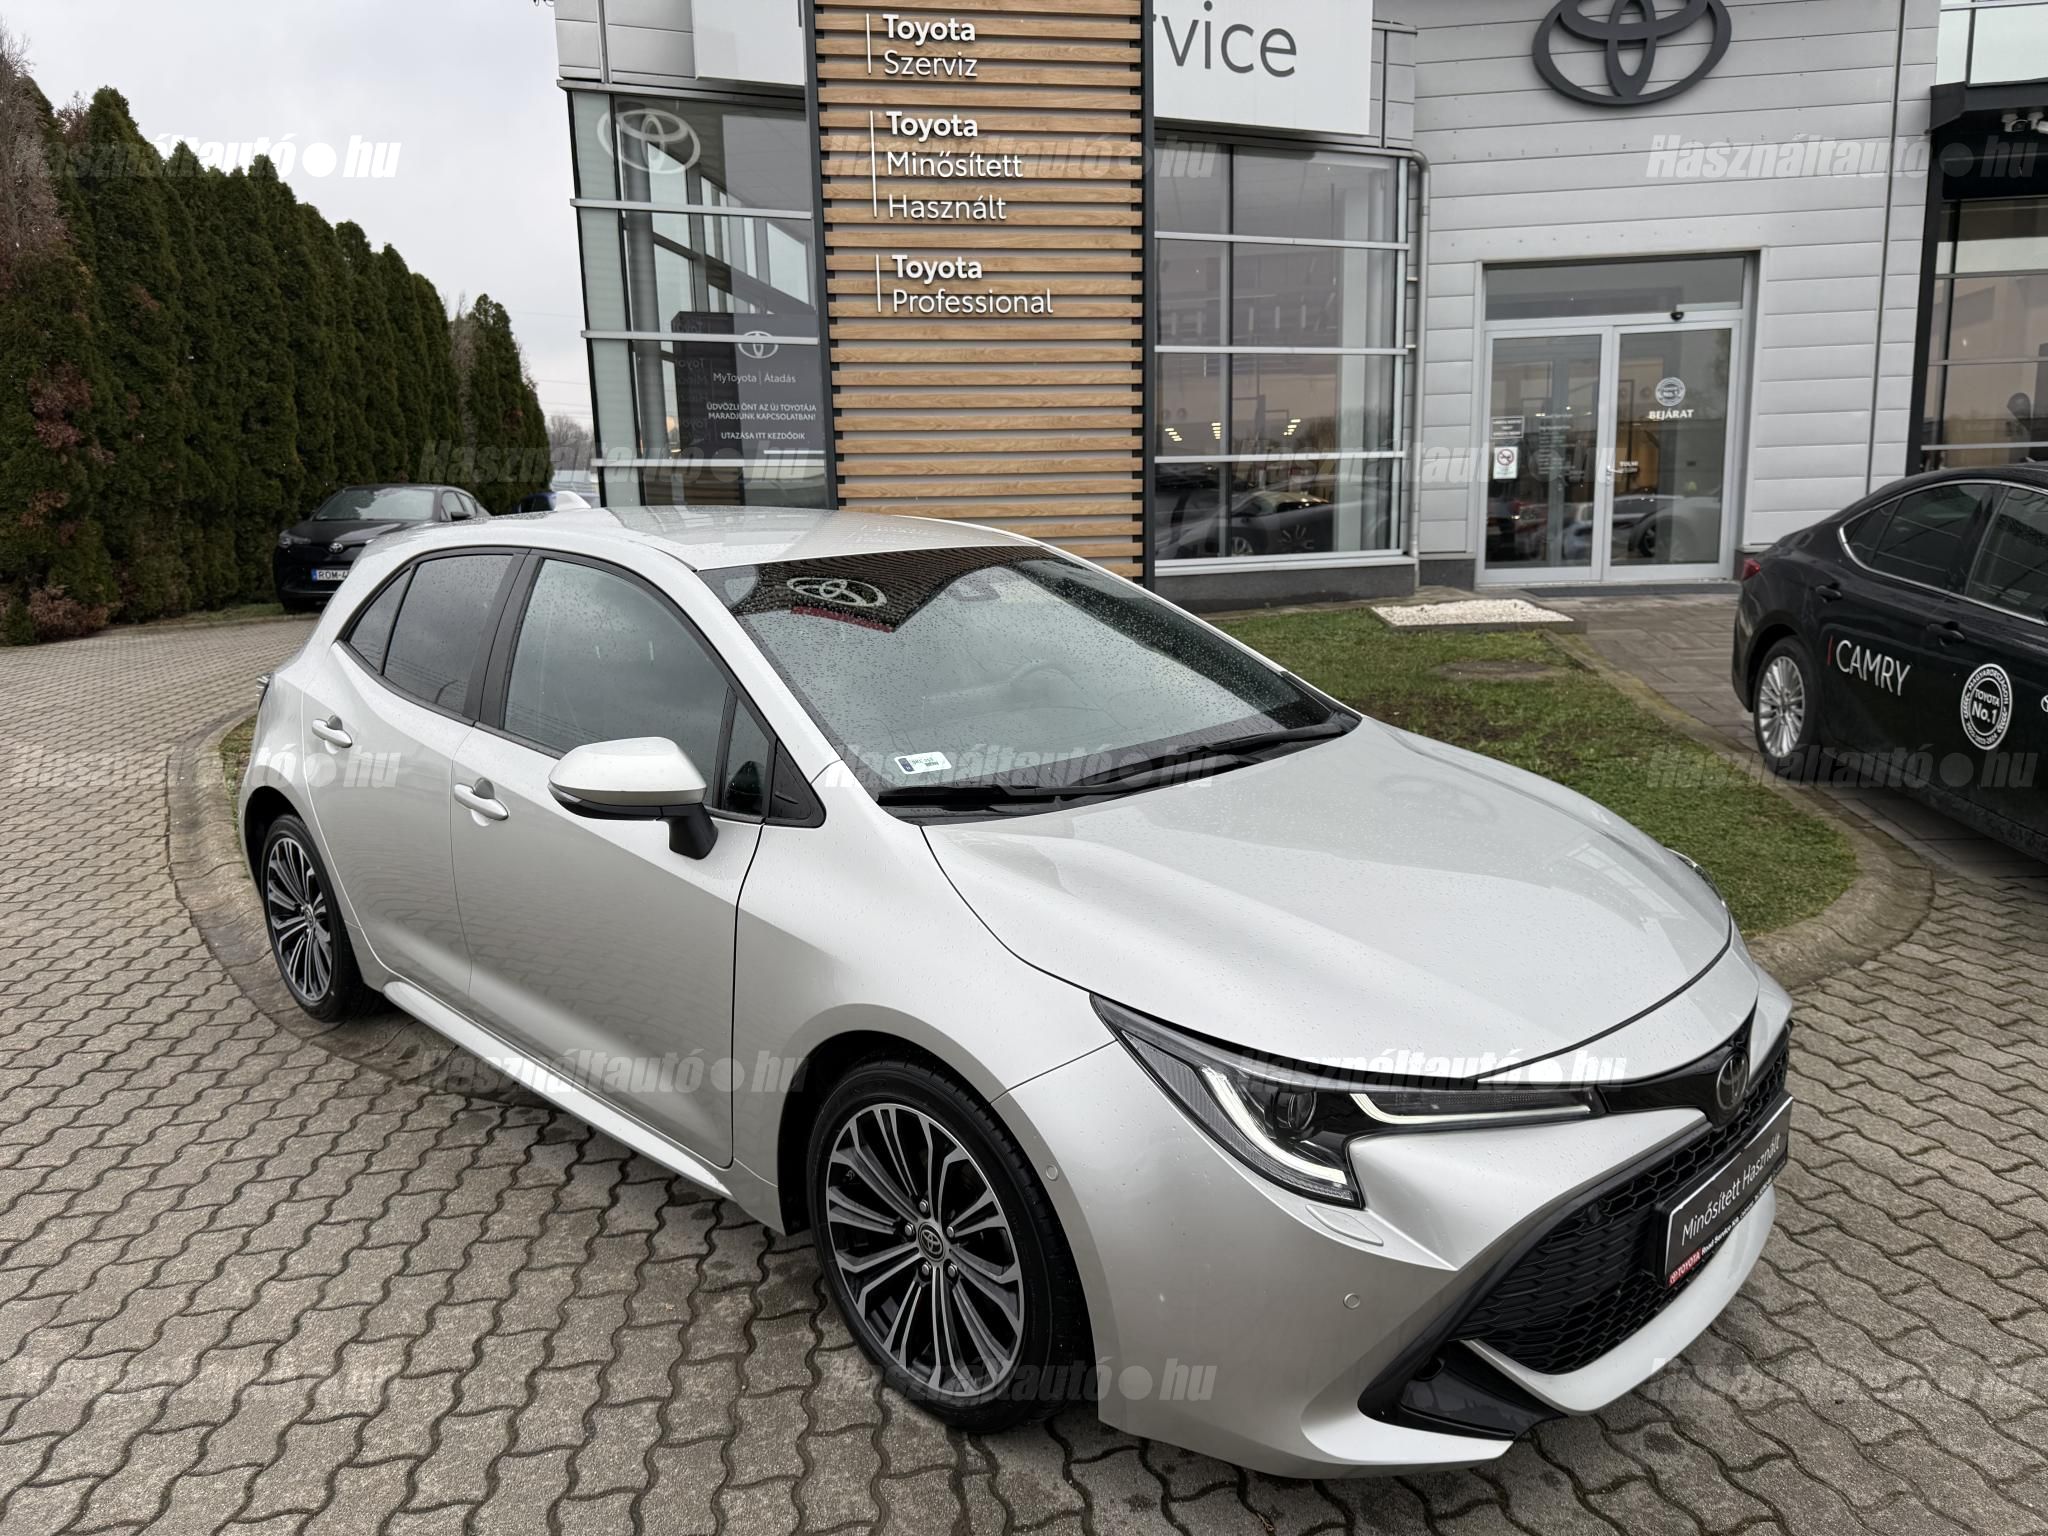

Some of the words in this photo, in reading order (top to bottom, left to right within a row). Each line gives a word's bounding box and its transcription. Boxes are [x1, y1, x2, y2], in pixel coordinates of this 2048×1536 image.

[882, 13, 976, 46] Toyota
[1153, 0, 1297, 78] vice
[884, 50, 978, 77] Szerviz
[886, 111, 978, 142] Toyota
[887, 150, 1024, 178] Minősített
[888, 194, 1007, 220] Használt
[891, 254, 983, 285] Toyota
[893, 288, 1054, 314] Professional
[713, 372, 757, 384] MyToyota
[764, 371, 797, 383] Átadás
[708, 412, 755, 421] MARADJUNK
[759, 403, 769, 411] AZ
[780, 403, 817, 412] TOYOTÁJA
[1649, 409, 1695, 421] BEJÁRAT
[720, 431, 755, 440] UTAZÁSA
[755, 432, 766, 440] ITT
[1835, 639, 1912, 697] CAMRY
[1975, 688, 2000, 707] TOYOTA
[1681, 1178, 1742, 1247] Minősített
[1742, 1132, 1781, 1190] Használt
